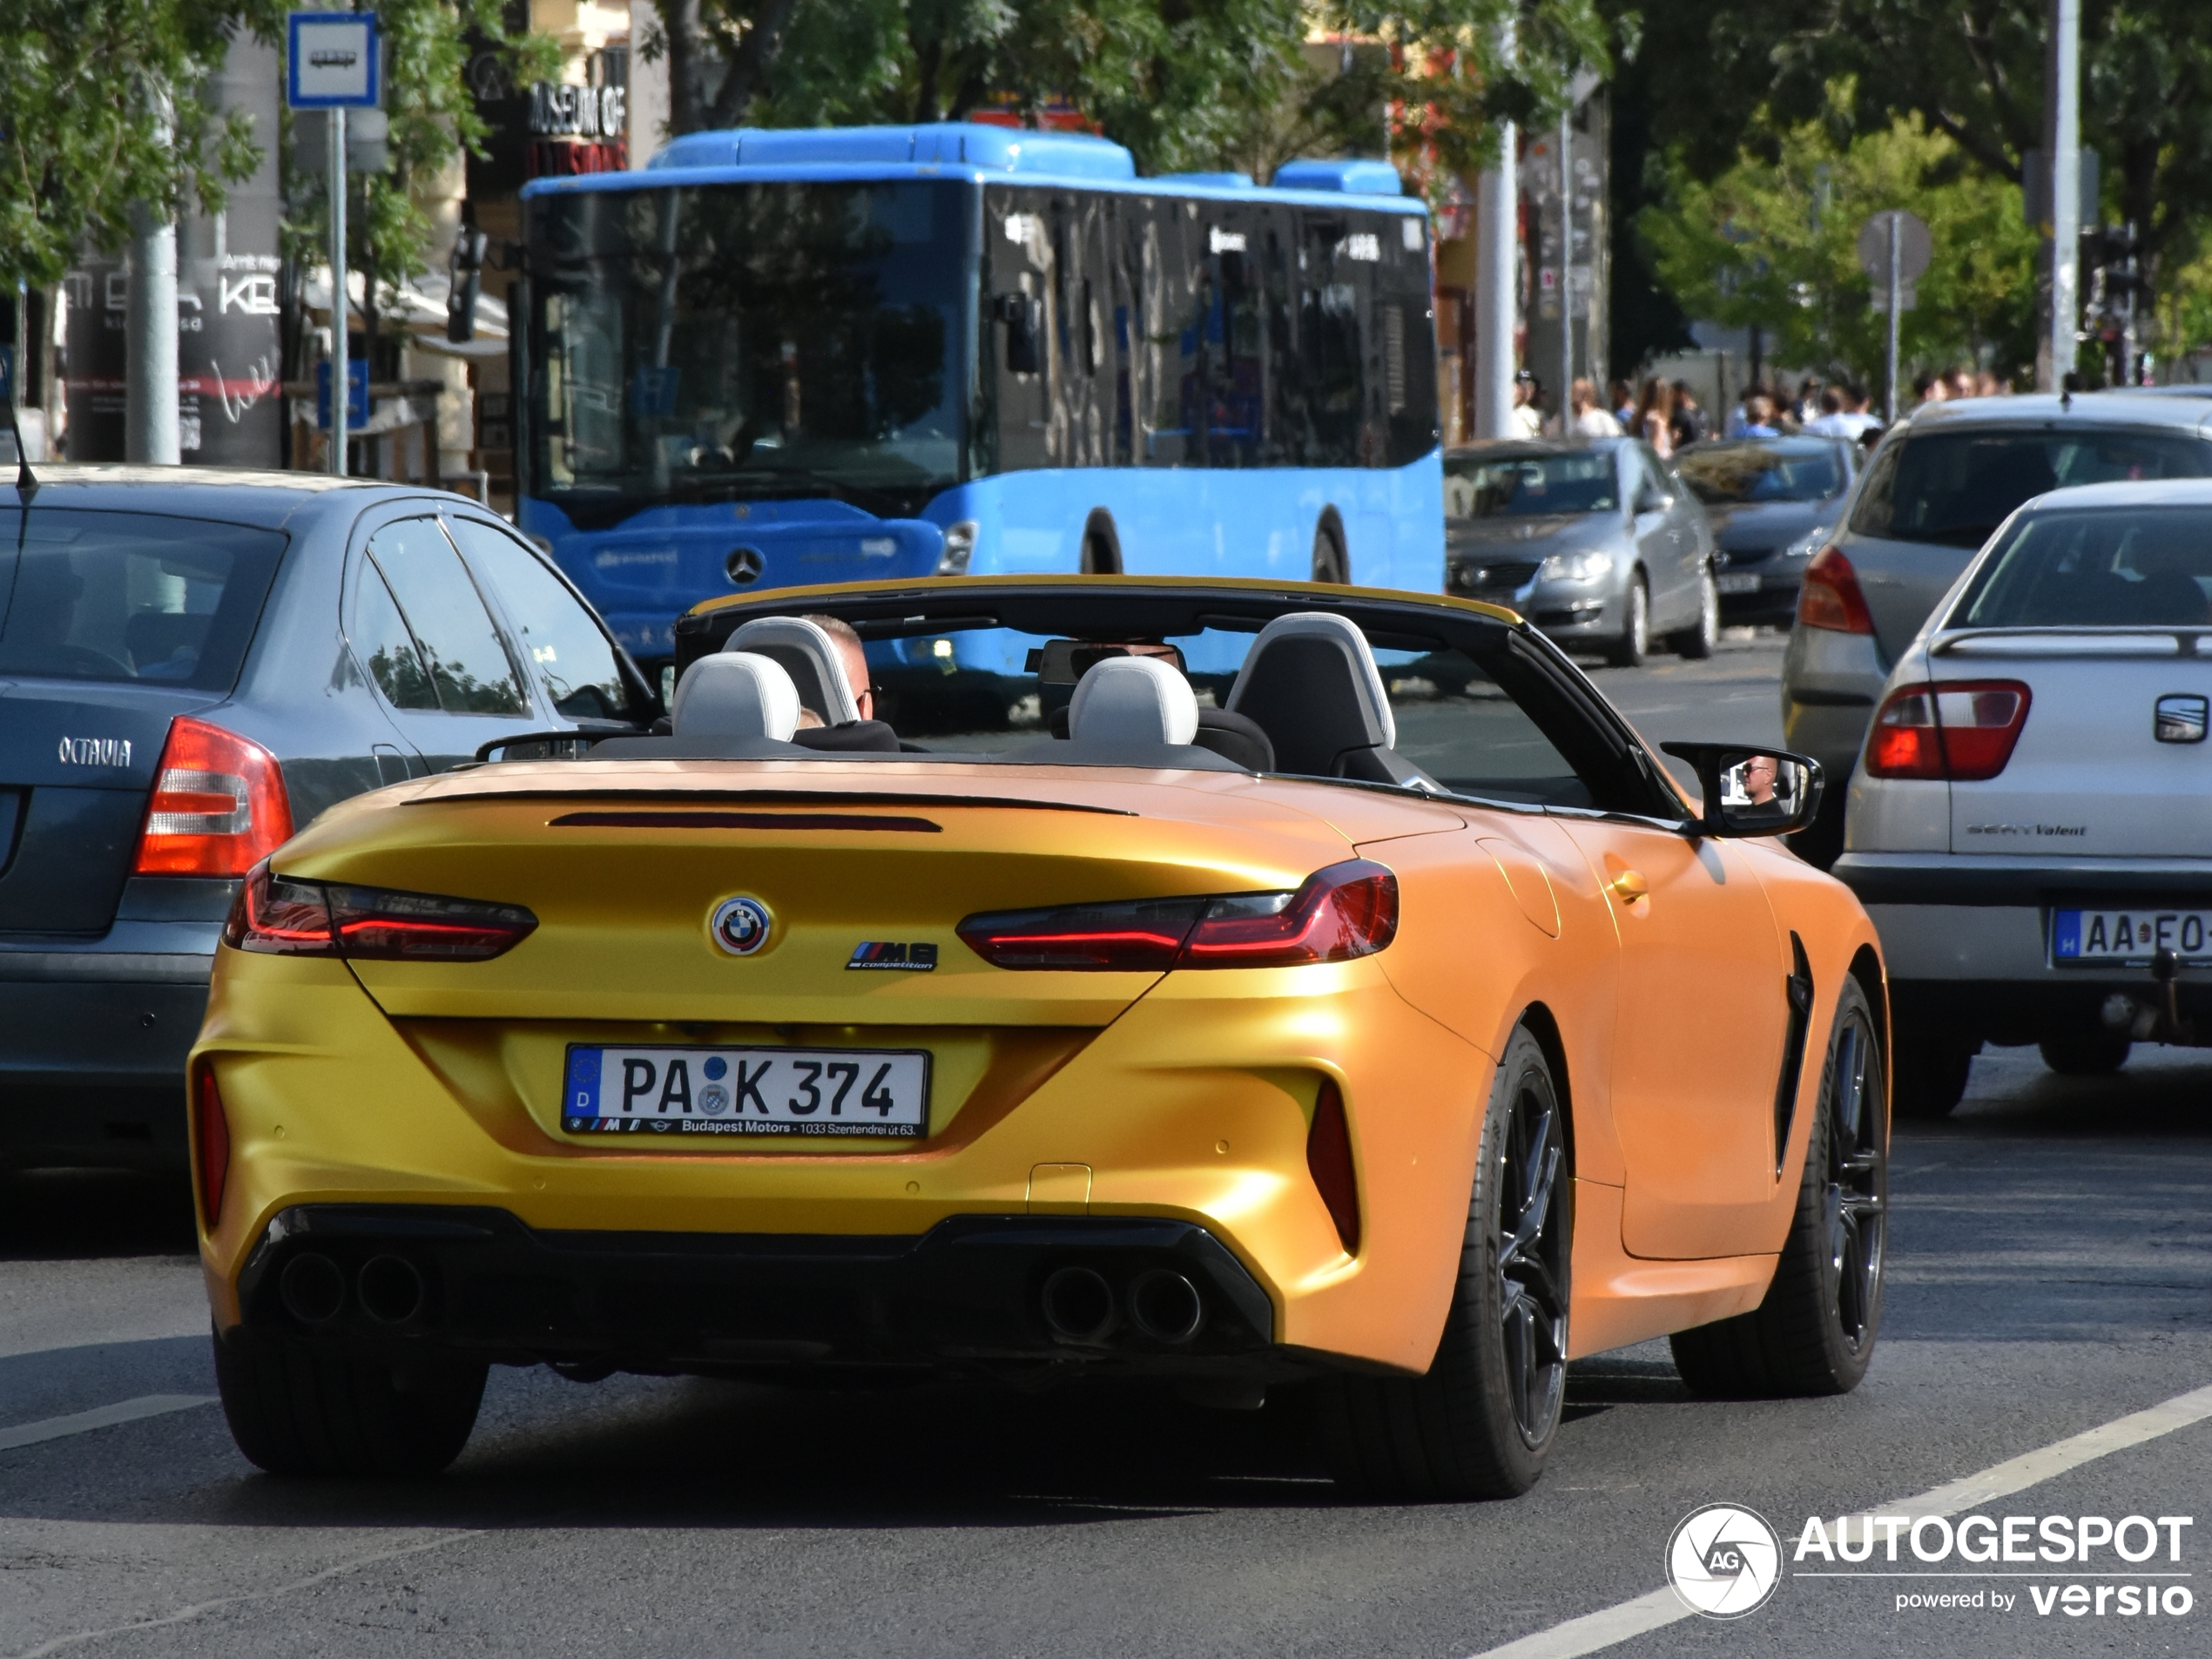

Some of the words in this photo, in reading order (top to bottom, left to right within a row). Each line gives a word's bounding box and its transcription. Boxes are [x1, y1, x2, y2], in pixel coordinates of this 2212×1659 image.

[602, 85, 625, 137] OF
[58, 737, 131, 767] OCTAVIA
[2087, 915, 2134, 951] AA
[860, 961, 934, 969] competition
[577, 1092, 589, 1107] D
[622, 1058, 692, 1113] PA
[735, 1060, 772, 1114] K
[788, 1062, 894, 1116] 374
[682, 1120, 742, 1133] Budapest
[745, 1121, 790, 1133] Motors
[800, 1123, 826, 1135] 1033
[827, 1123, 887, 1135] Szentendrei
[900, 1125, 916, 1136] 63.
